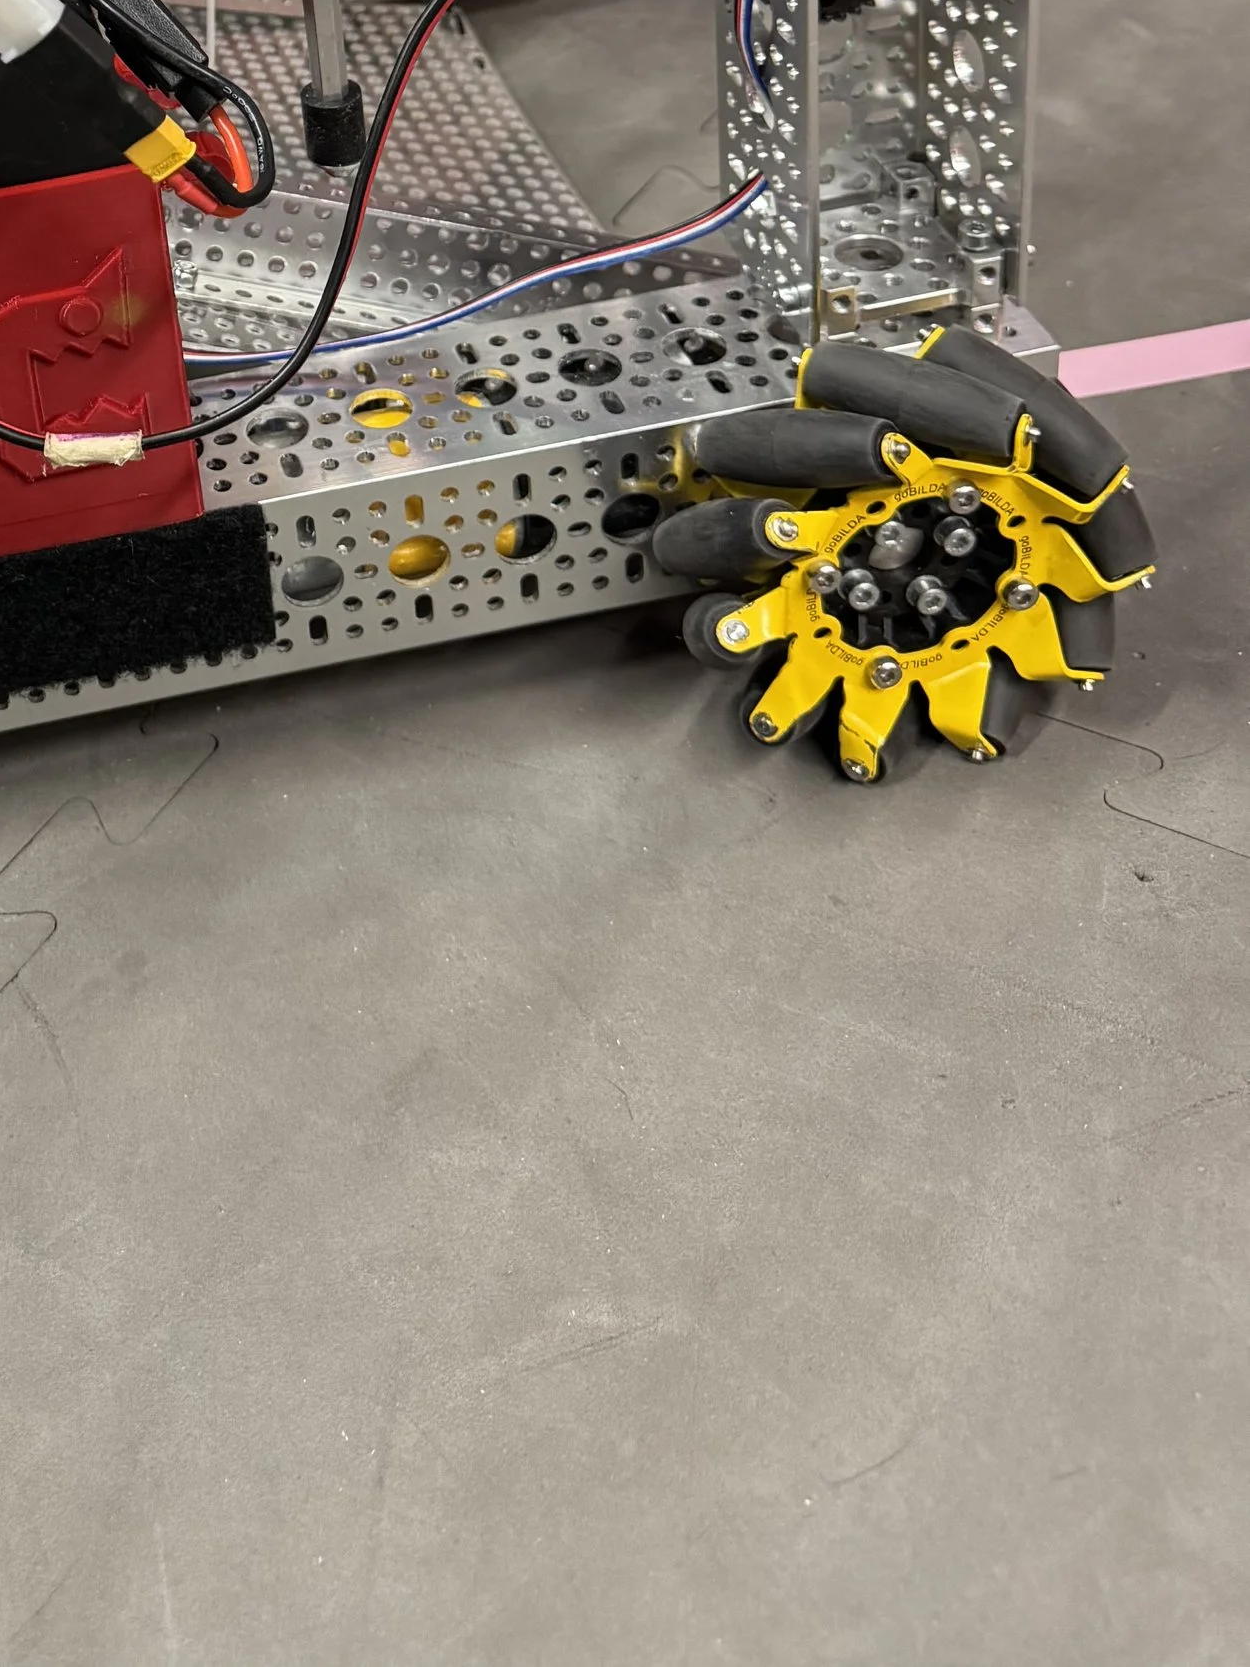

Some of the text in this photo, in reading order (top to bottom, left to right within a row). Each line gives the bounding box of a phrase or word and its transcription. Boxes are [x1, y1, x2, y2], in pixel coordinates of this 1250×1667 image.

[894, 483, 948, 502] goBILDA
[824, 514, 867, 554] goBILDA
[825, 640, 864, 666] goBILDA
[901, 653, 943, 670] goBILD
